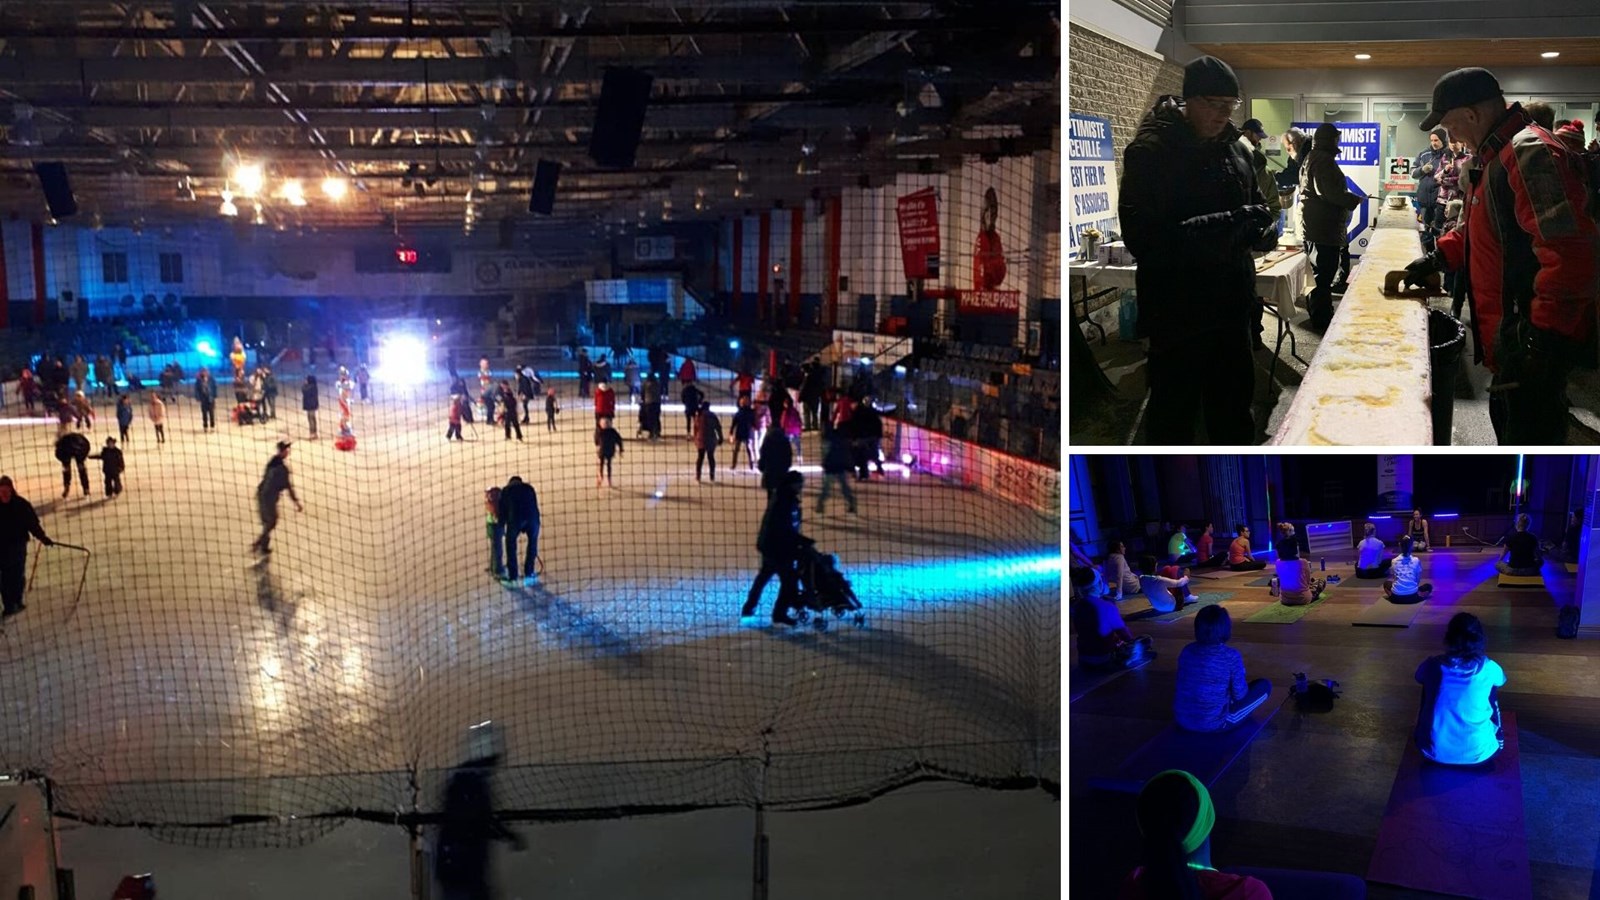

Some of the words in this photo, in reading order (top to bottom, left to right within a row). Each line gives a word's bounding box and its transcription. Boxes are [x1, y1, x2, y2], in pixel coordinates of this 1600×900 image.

[1069, 119, 1105, 139] TIMISTE
[1069, 139, 1101, 158] CEVILLE
[1071, 166, 1083, 187] EST
[1084, 165, 1098, 186] FIER
[1097, 165, 1106, 185] DE
[1074, 192, 1109, 216] S'ASSOCIER
